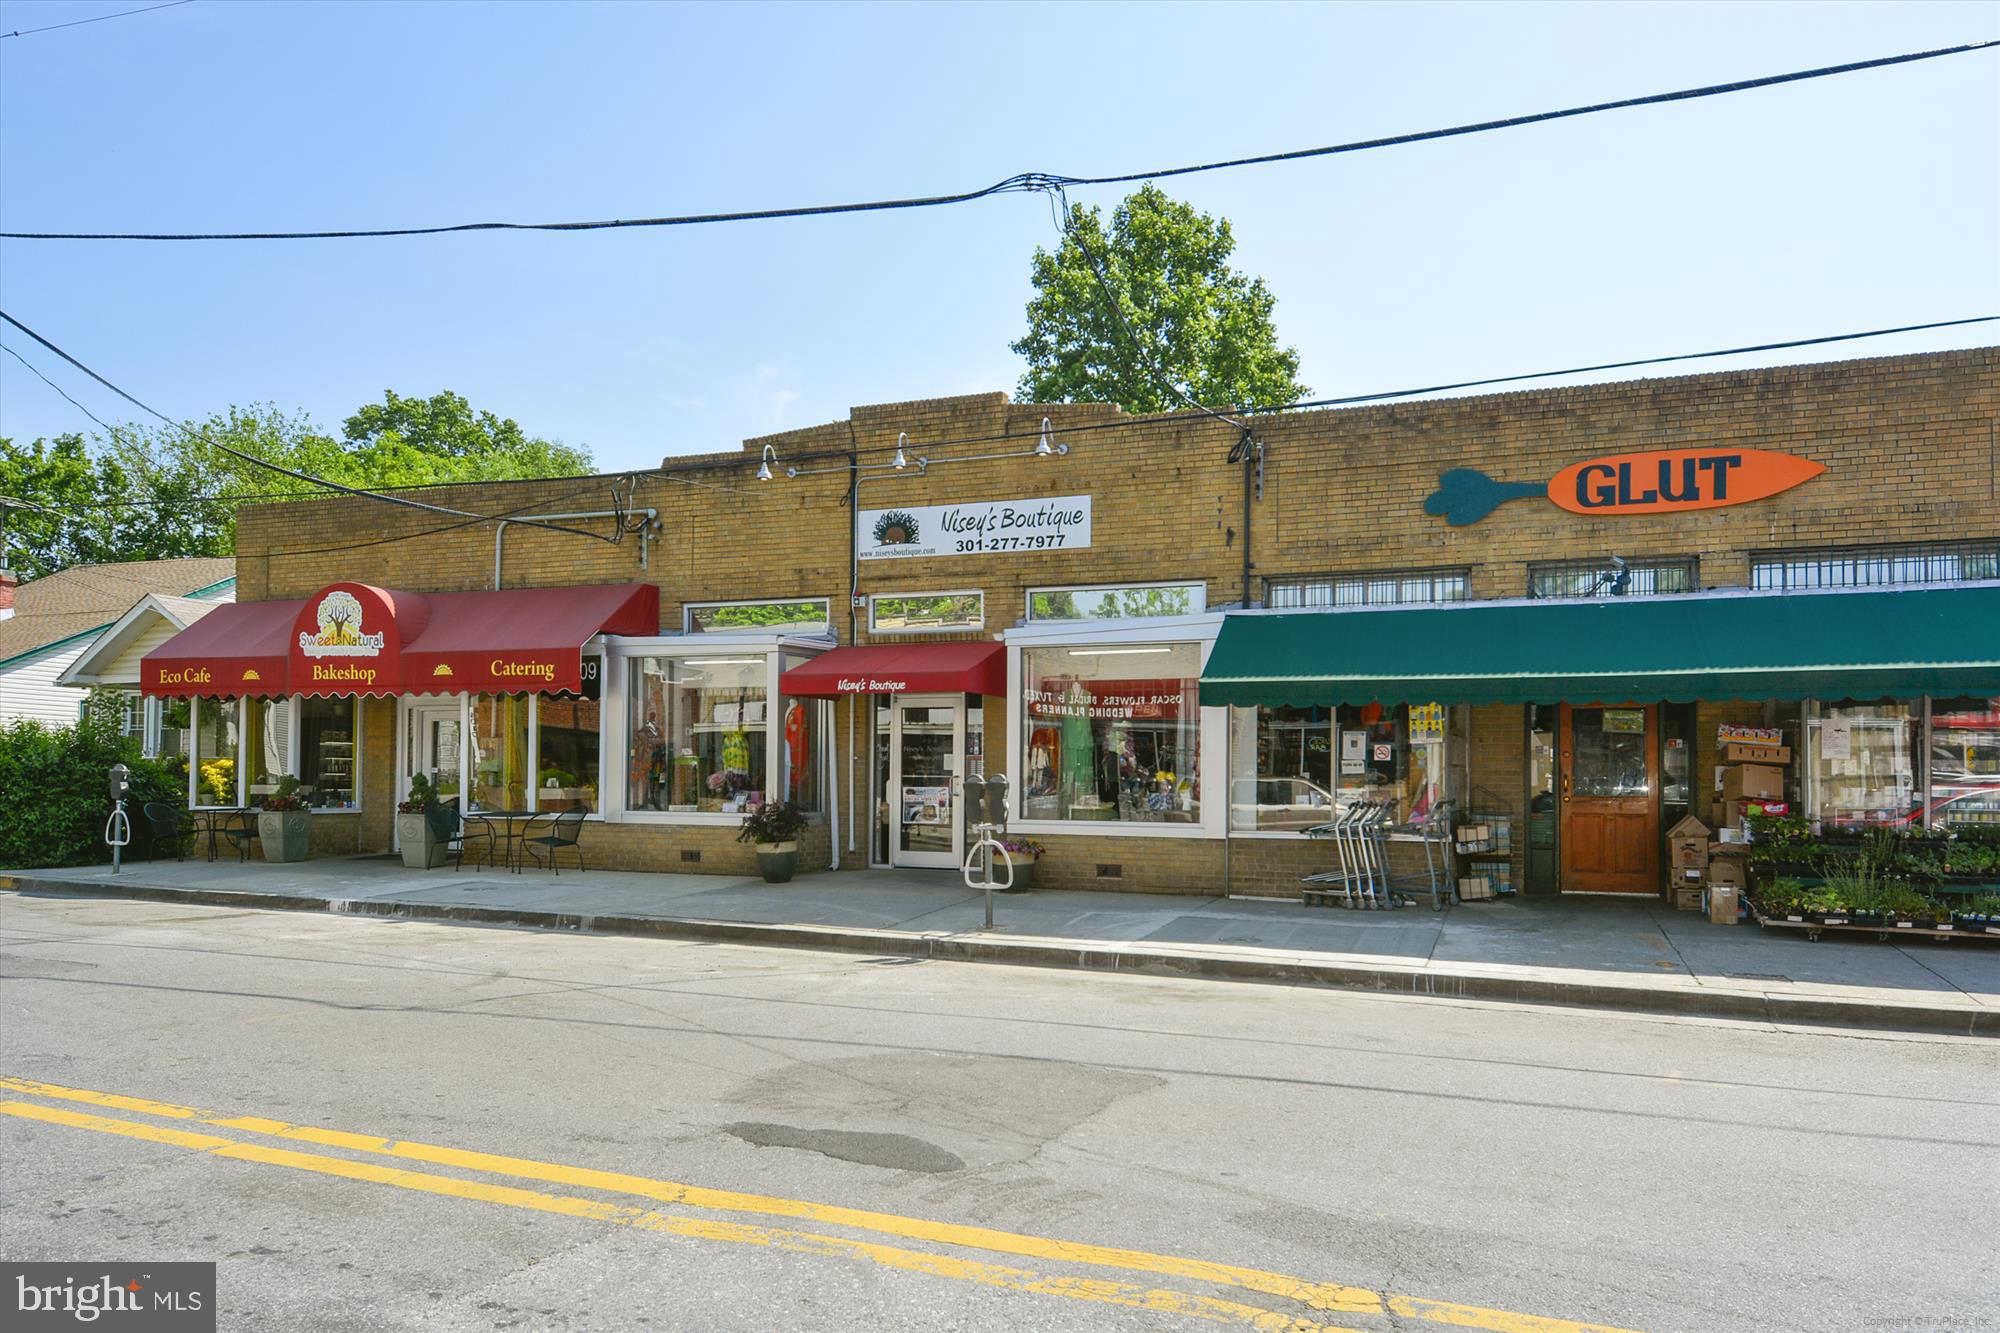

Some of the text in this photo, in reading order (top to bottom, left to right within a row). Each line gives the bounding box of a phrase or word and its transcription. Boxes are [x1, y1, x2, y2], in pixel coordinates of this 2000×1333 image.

[1576, 455, 1742, 508] GLUT
[941, 502, 1084, 536] Nisey's Boutique
[956, 534, 1066, 553] 301-277-7977
[300, 633, 336, 646] Sweet
[343, 632, 383, 647] Natural
[159, 667, 212, 684] Eco Cafe
[312, 664, 376, 685] Bakeshop
[490, 660, 555, 682] Catering
[869, 680, 906, 693] Boutique
